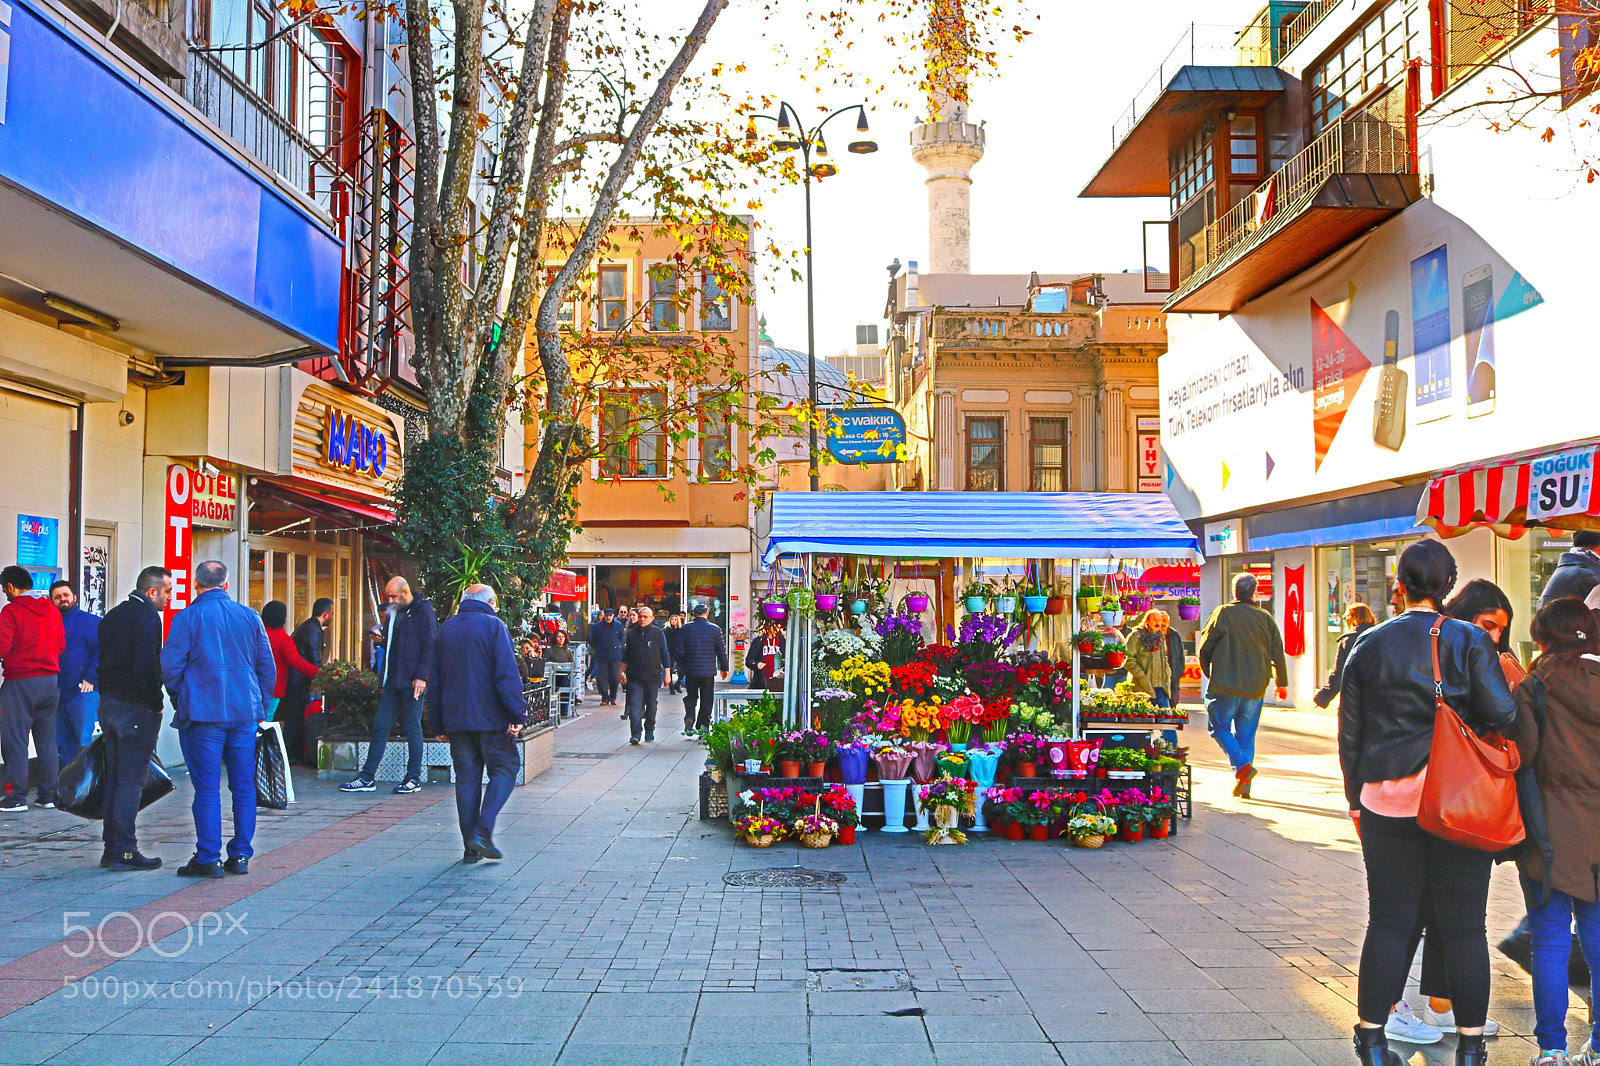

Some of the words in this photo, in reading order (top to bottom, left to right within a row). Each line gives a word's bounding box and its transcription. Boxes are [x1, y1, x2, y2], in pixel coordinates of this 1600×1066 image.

[1186, 402, 1221, 431] Telekom
[1283, 363, 1304, 393] alın
[328, 407, 387, 478] MADO
[1145, 437, 1157, 474] THY
[1533, 453, 1591, 477] SOĞUK
[193, 469, 236, 499] OTEL
[1539, 474, 1580, 511] SU
[192, 498, 236, 522] BAĞDAT
